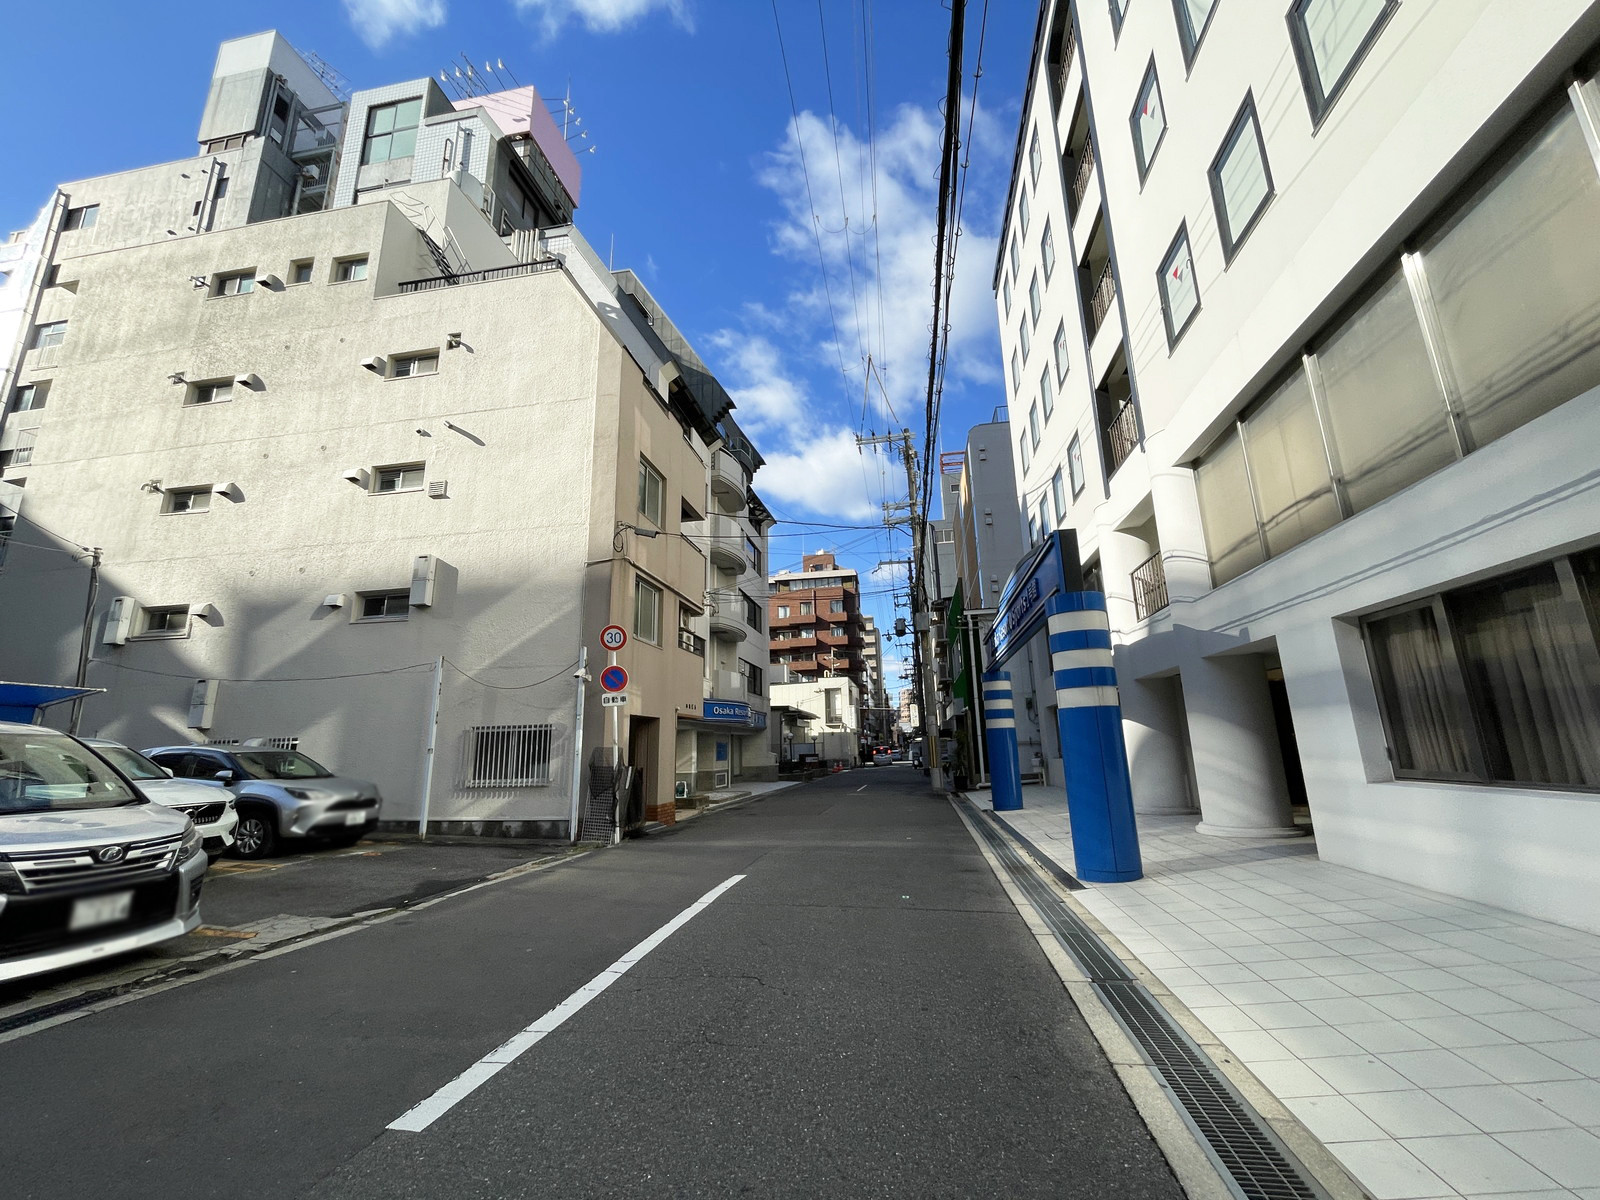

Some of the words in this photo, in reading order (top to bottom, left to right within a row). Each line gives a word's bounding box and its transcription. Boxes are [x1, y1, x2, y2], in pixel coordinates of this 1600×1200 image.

[606, 632, 622, 644] 30
[603, 695, 627, 704] 自動車
[713, 706, 734, 715] Osaka
